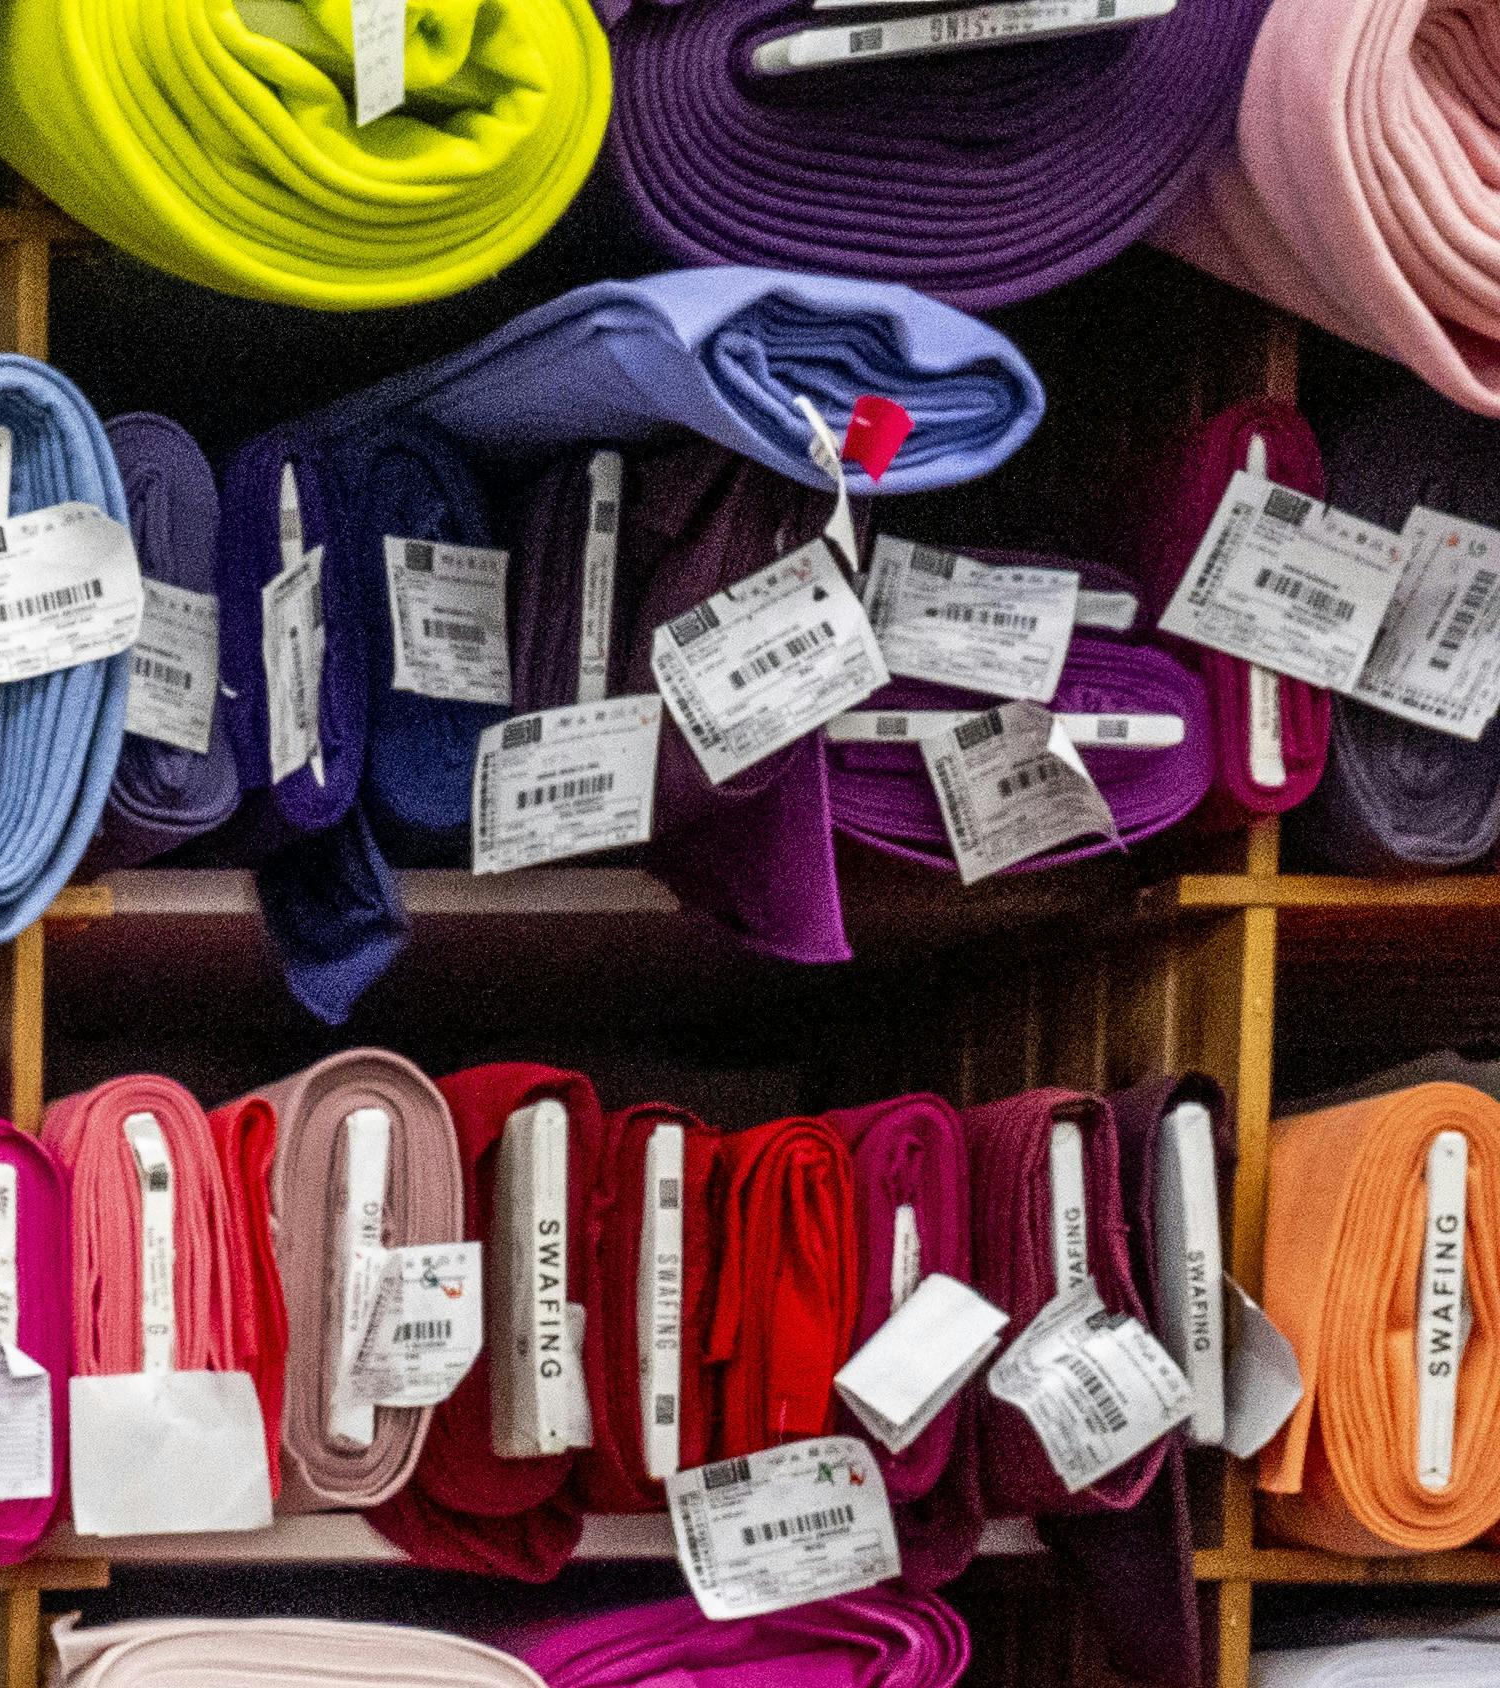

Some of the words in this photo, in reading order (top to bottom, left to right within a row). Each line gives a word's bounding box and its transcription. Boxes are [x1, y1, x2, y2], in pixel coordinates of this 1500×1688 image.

[538, 1218, 562, 1380] SWAFING
[1185, 1249, 1210, 1352] SWAFING
[1429, 1212, 1459, 1378] SWAFING
